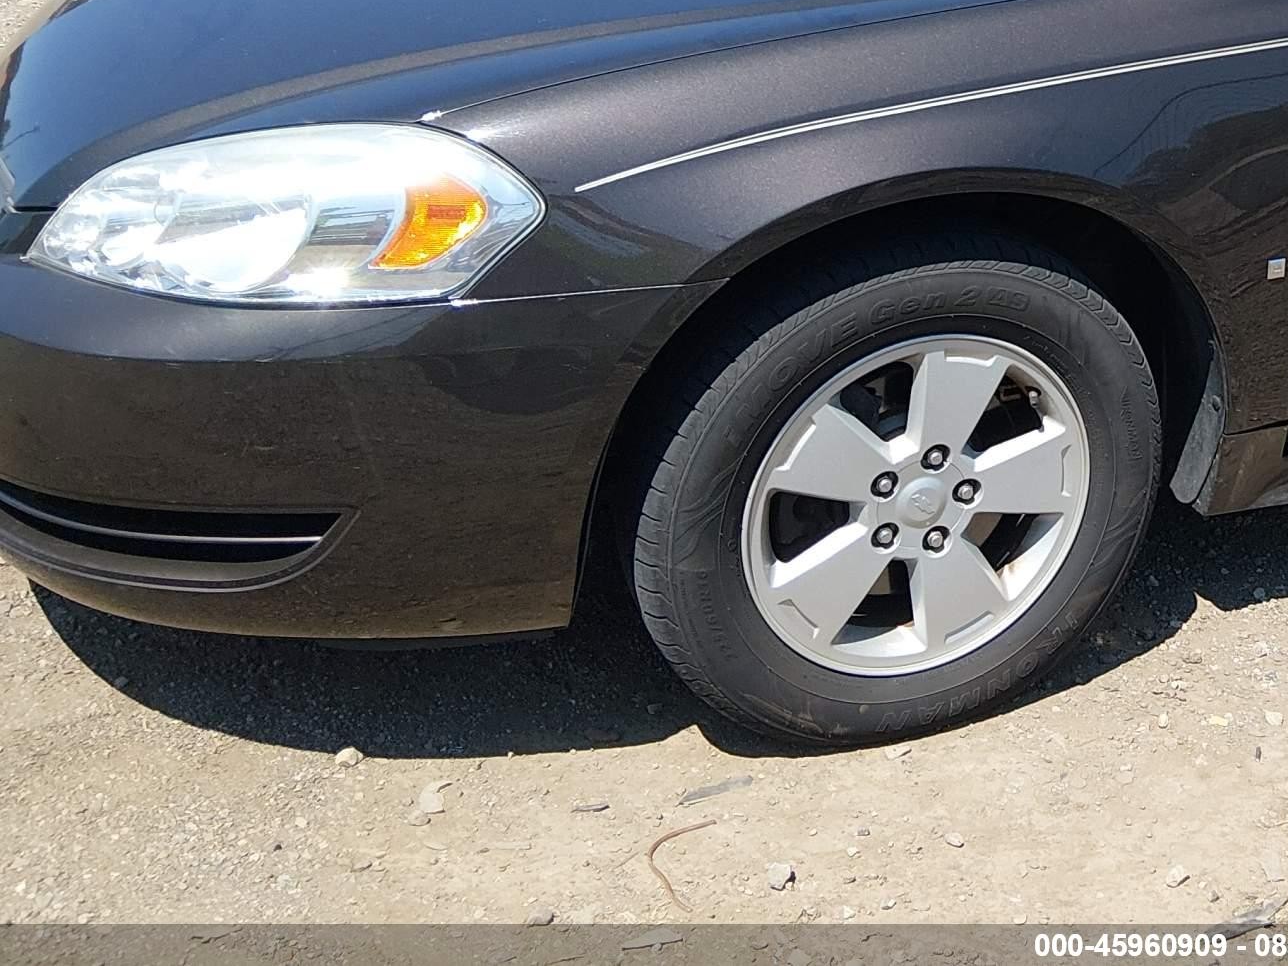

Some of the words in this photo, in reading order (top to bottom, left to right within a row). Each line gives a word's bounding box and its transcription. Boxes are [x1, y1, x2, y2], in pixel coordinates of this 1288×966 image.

[868, 290, 947, 326] Gen
[953, 285, 980, 308] 2
[875, 611, 1079, 733] IRONMAN
